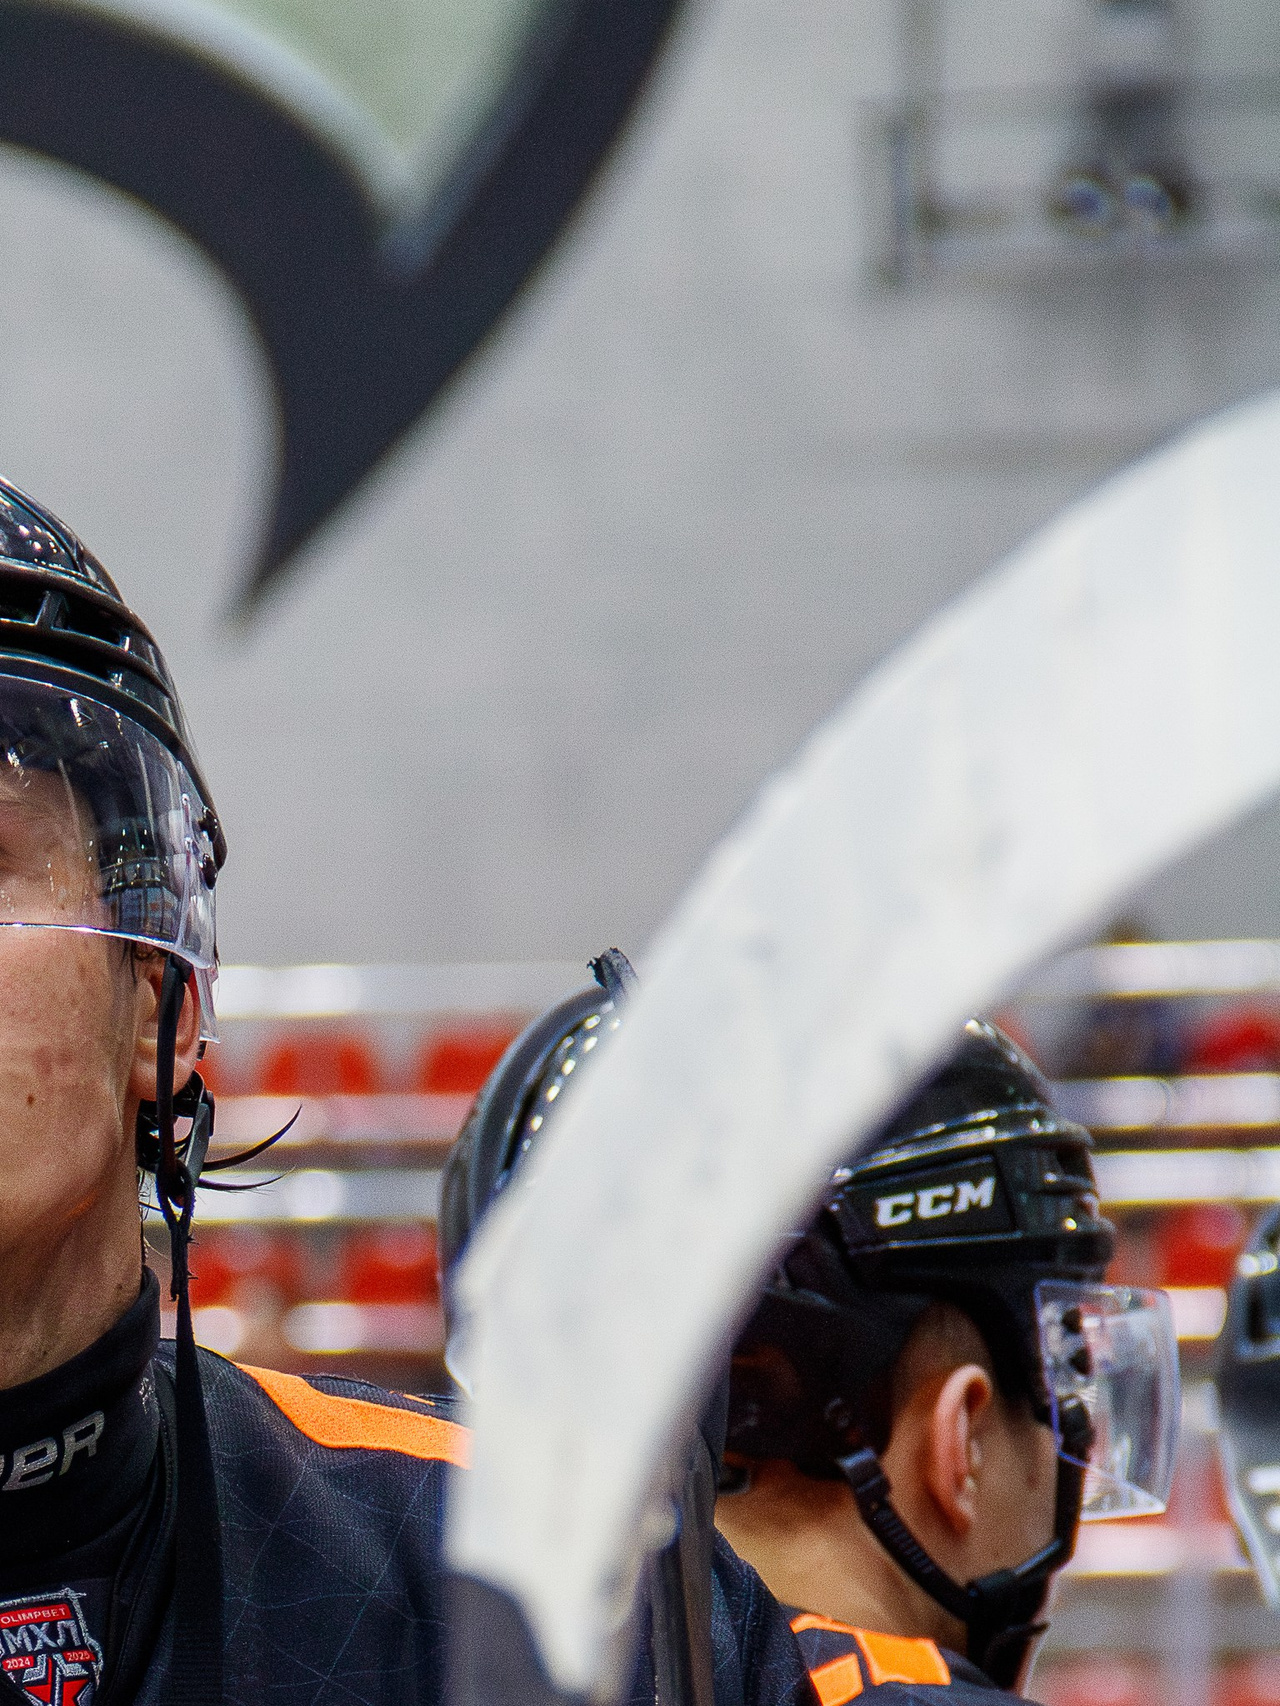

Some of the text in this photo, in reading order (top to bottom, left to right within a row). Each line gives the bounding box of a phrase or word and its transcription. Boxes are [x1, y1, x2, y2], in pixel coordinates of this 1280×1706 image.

[875, 1175, 996, 1229] CCM
[0, 1607, 66, 1625] OLIMPBET
[1, 1620, 81, 1654] МХЛ
[6, 1650, 91, 1670] 2024 2025
